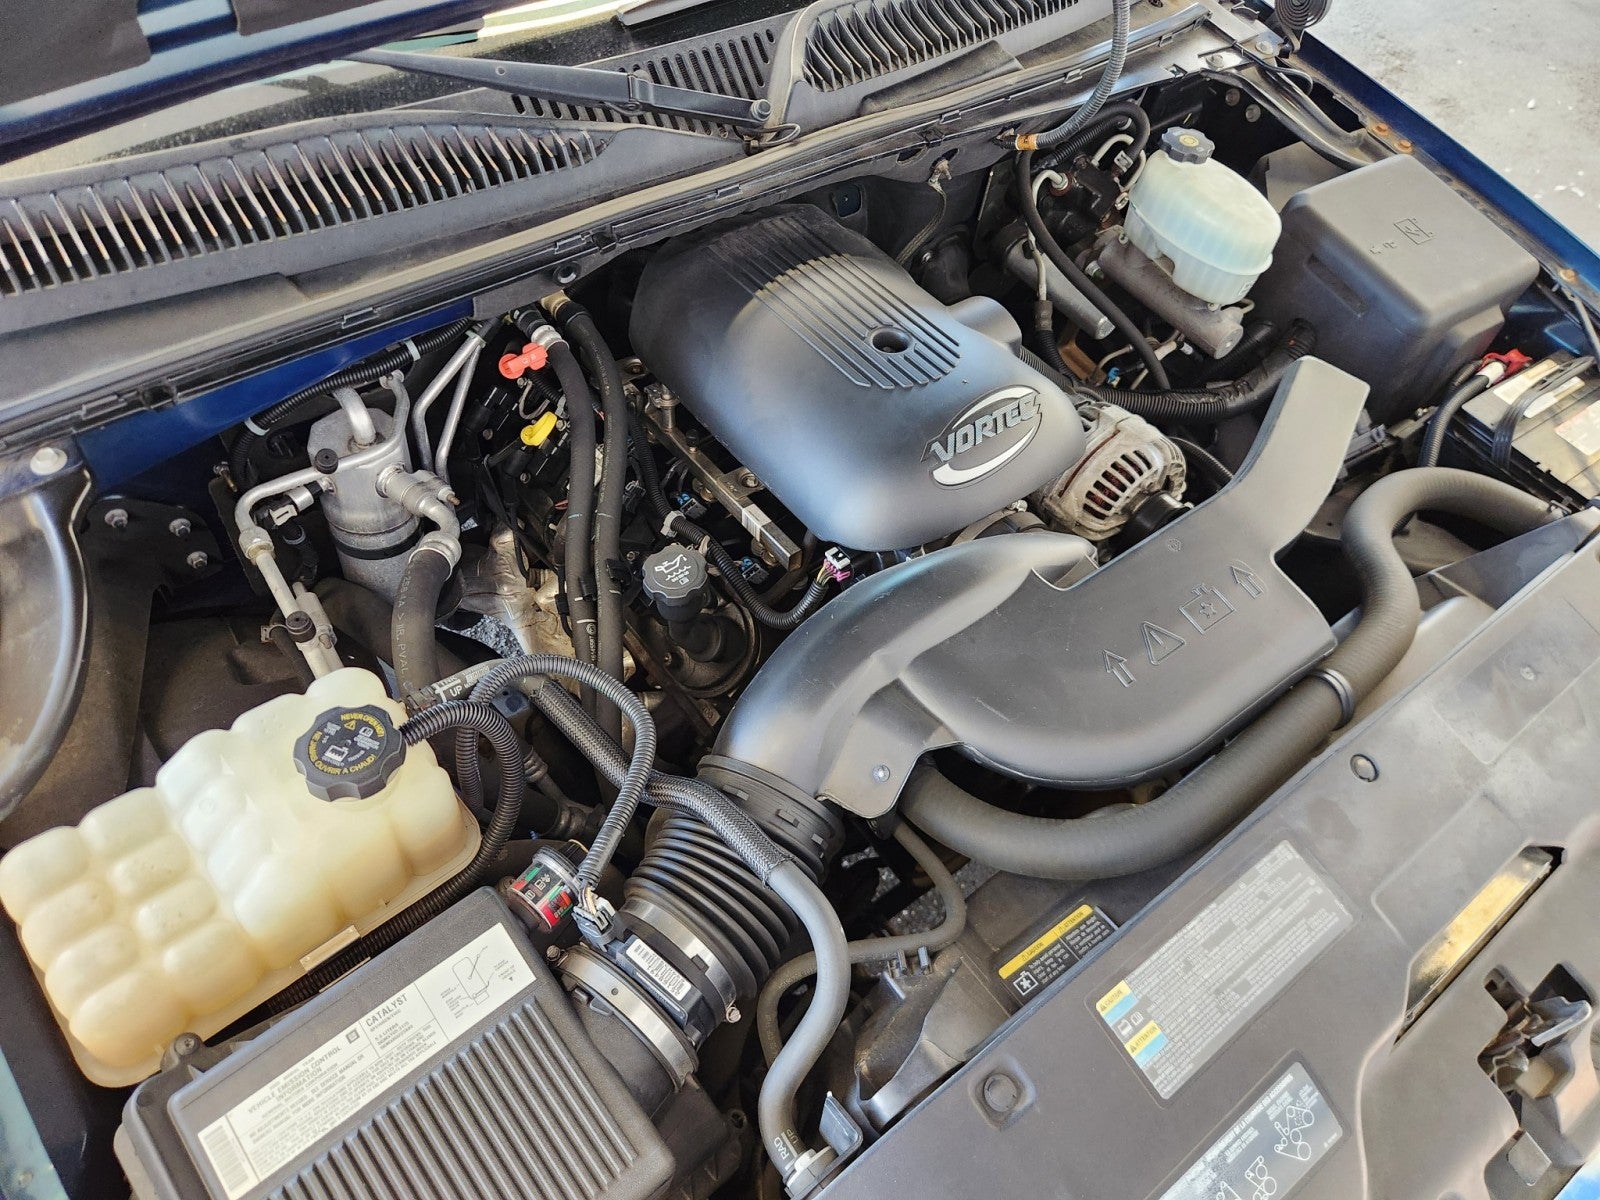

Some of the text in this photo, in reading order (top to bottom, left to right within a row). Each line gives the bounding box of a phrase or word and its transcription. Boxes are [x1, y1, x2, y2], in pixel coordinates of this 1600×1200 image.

[928, 392, 1039, 461] VORTEC
[449, 685, 463, 697] UP
[340, 712, 363, 722] NEVER
[362, 714, 378, 728] OPEN
[314, 760, 341, 775] OUVRIR
[365, 993, 408, 1026] CATALYST
[248, 1045, 341, 1114] VEHICLE EMISSION CONTROL
[276, 1066, 322, 1102] INFORMATION
[773, 1136, 790, 1160] RAD
[786, 1128, 799, 1145] UP
